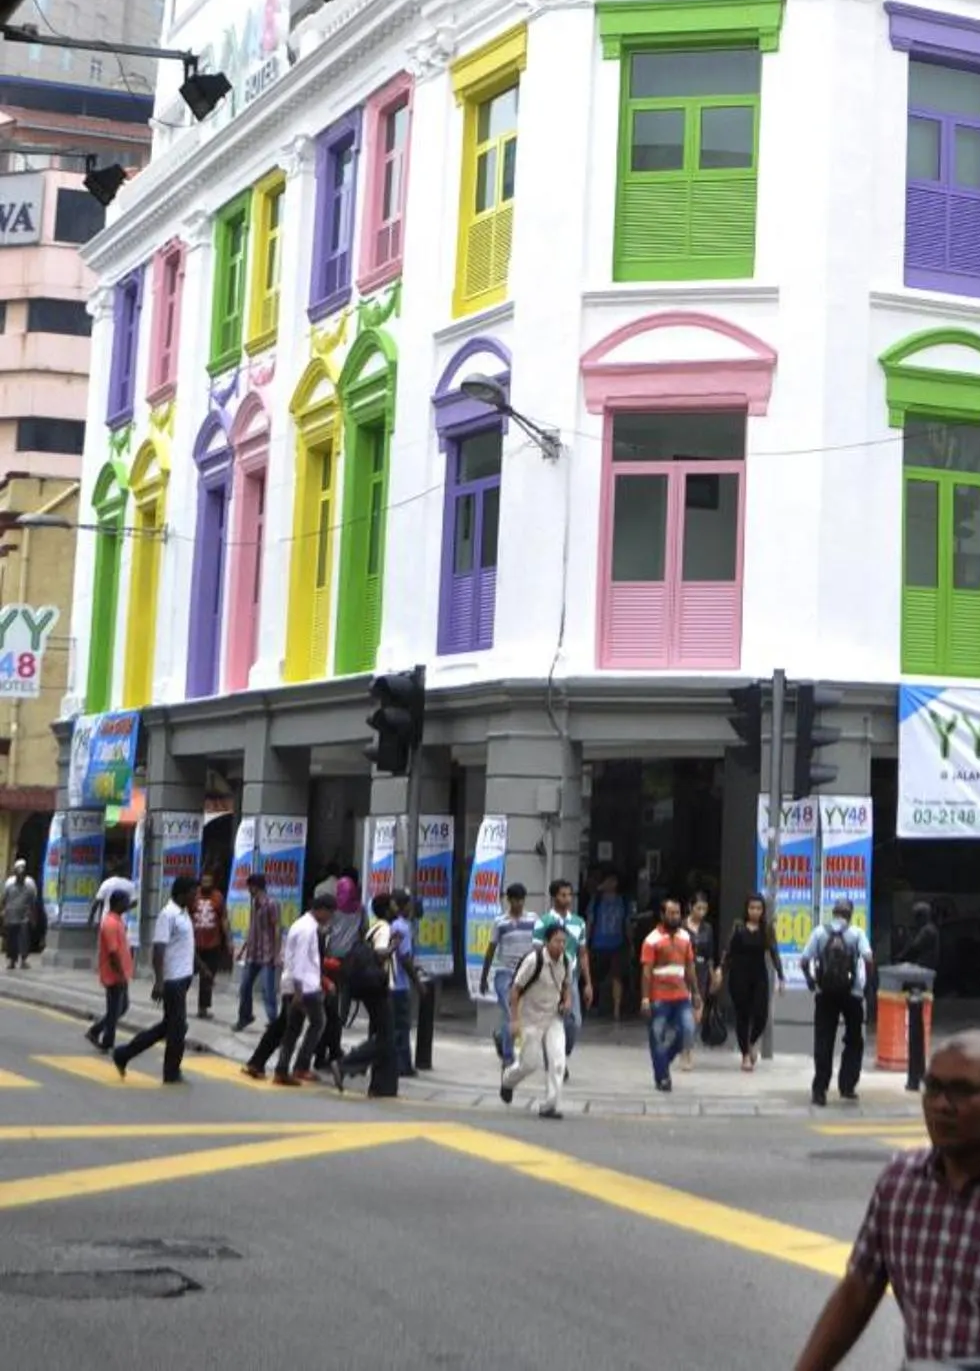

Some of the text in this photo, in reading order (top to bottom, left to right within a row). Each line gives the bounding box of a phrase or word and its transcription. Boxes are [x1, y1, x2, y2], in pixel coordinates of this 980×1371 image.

[0, 651, 36, 678] 48
[824, 805, 867, 825] YY48
[265, 821, 304, 838] YY48
[421, 822, 450, 842] Y48
[824, 855, 866, 873] HOTEL
